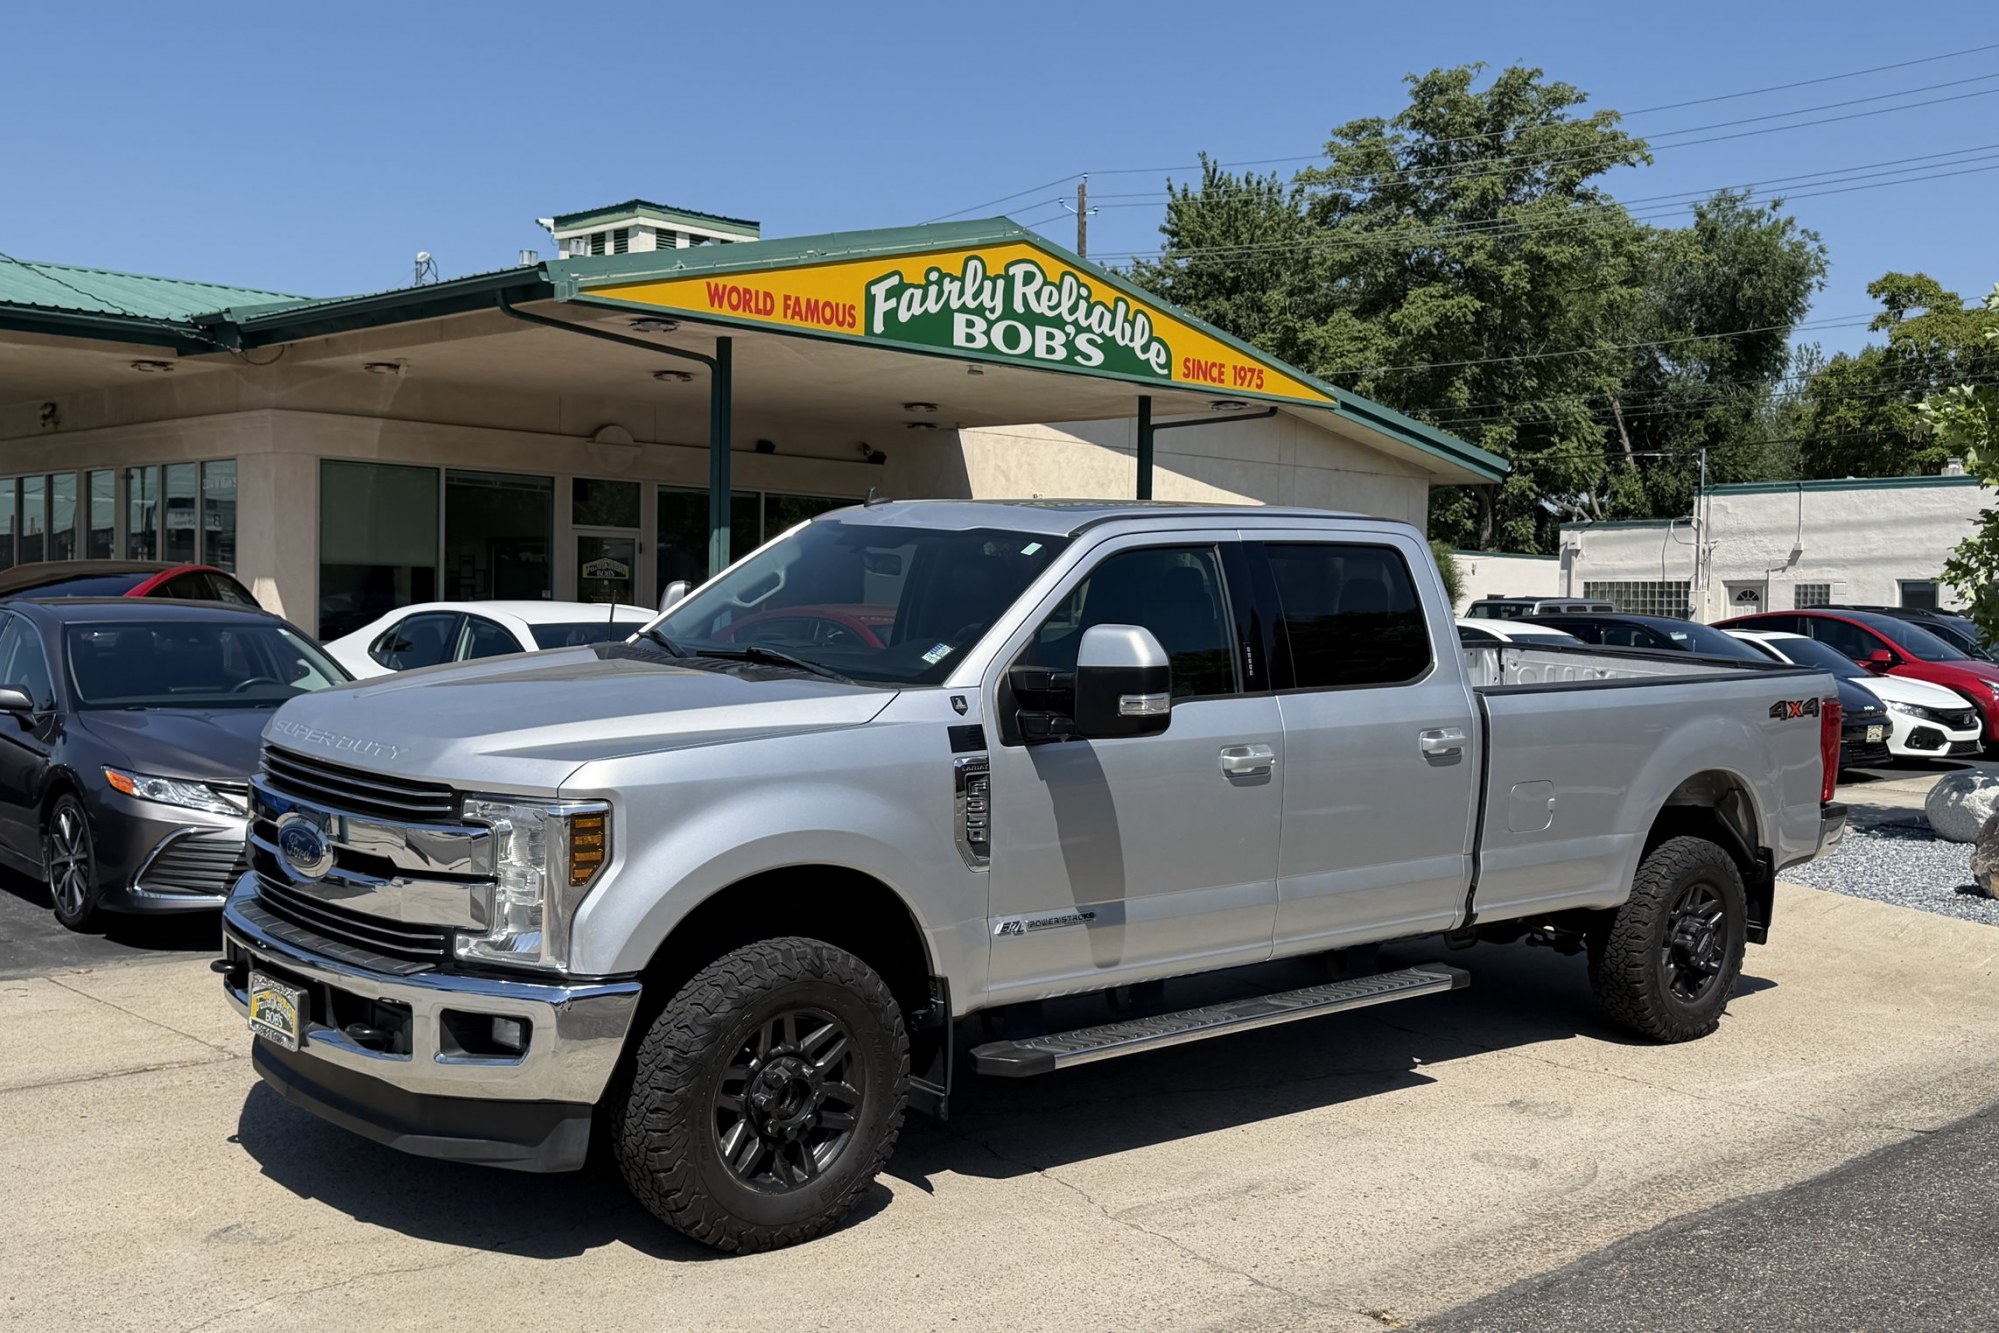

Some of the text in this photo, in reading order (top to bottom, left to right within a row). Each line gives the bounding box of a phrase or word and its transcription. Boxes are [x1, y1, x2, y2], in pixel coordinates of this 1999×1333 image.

[706, 281, 857, 329] WORLD FAMOUS
[871, 259, 1168, 374] Fairly Reliable
[953, 312, 1105, 366] BOB'S
[1183, 357, 1264, 390] SINCE 1975
[273, 719, 409, 759] SUPER DUTY
[286, 831, 313, 862] Ford
